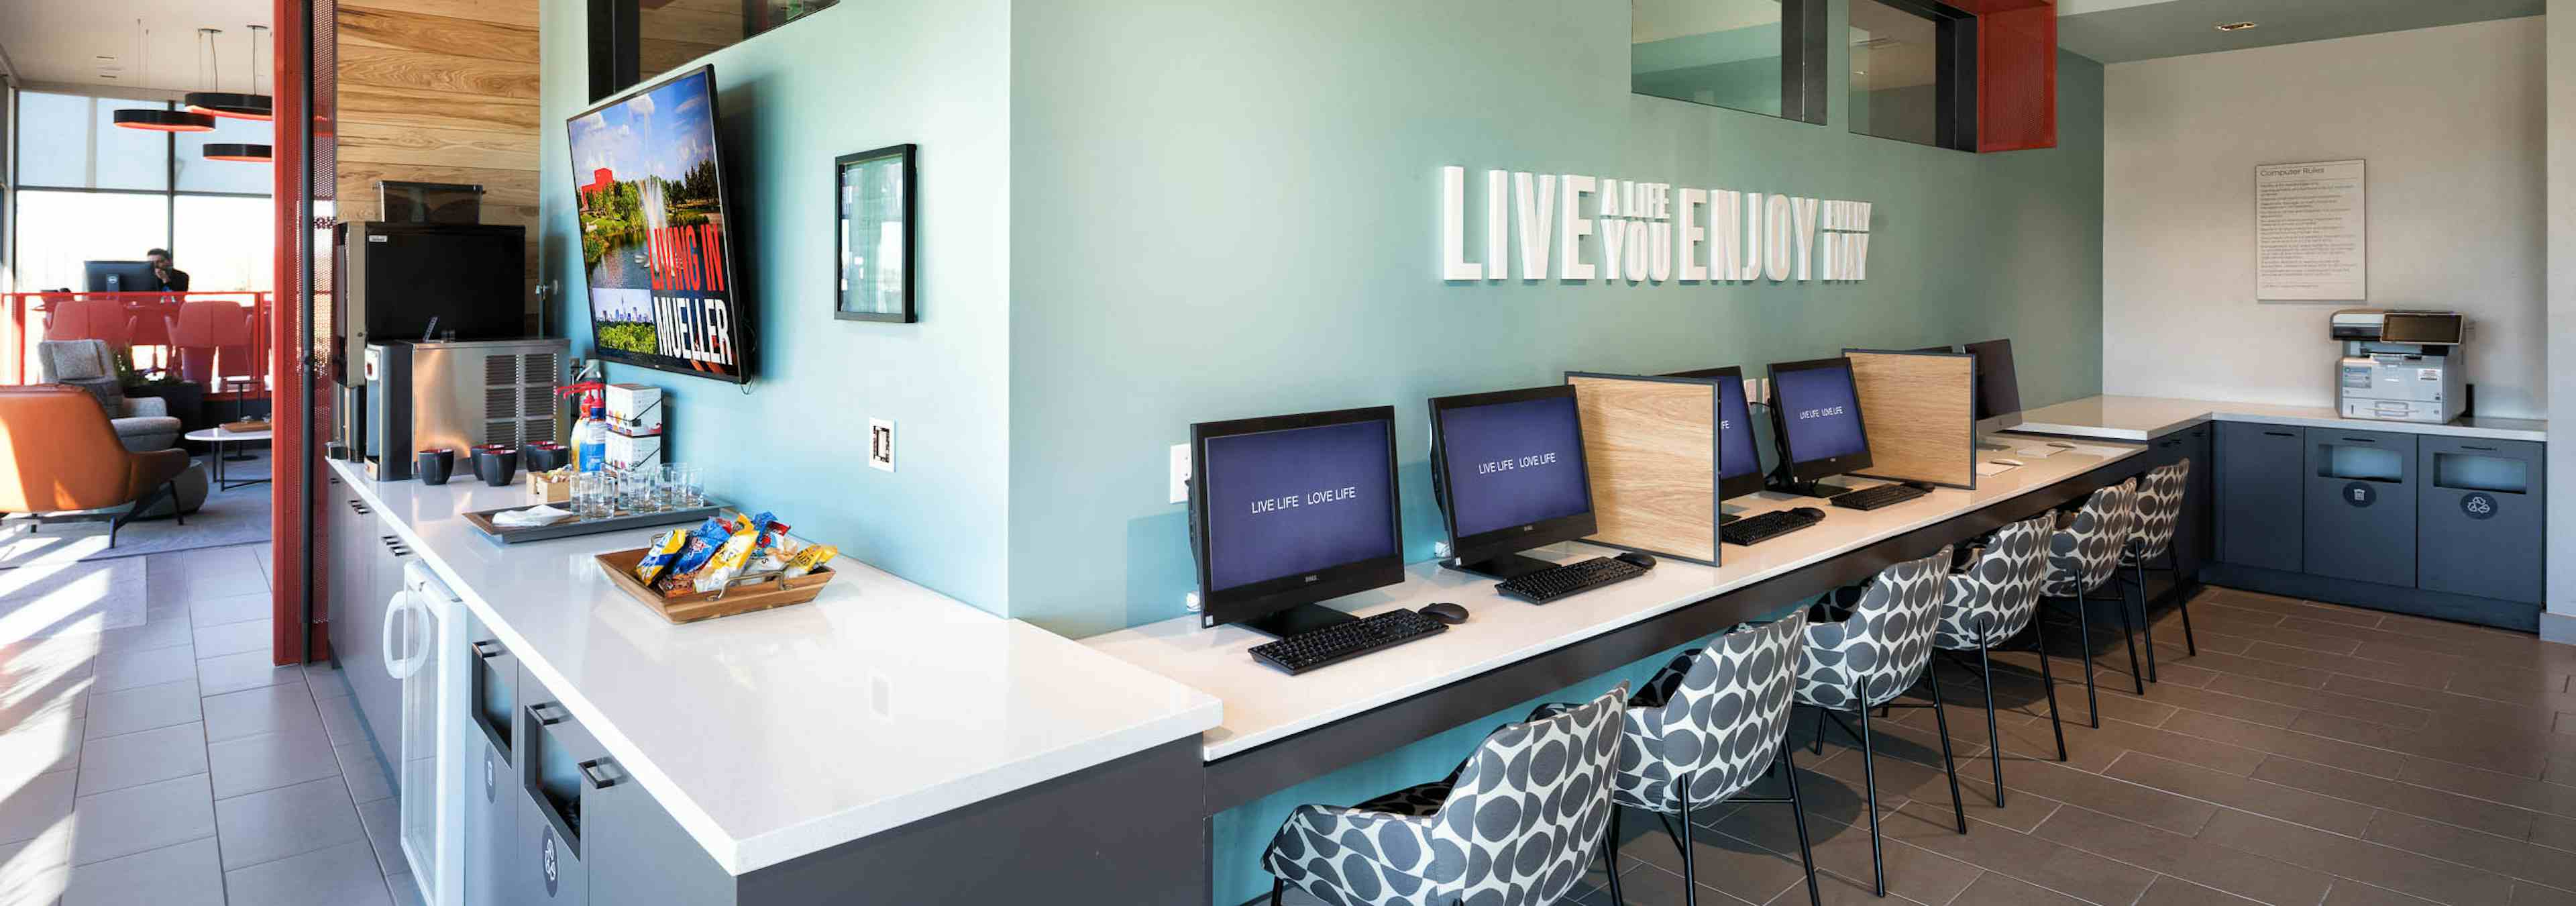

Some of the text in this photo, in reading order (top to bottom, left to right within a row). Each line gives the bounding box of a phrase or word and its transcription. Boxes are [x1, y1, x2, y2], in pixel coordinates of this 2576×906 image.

[1444, 166, 1596, 281] LIVE
[1601, 179, 1670, 219] A LIFE
[646, 223, 724, 291] LIVING IN
[1601, 219, 1671, 281] YOU
[1678, 187, 1819, 281] ENJOY
[1823, 232, 1870, 281] DAY
[653, 296, 733, 365] MUELLER
[1721, 420, 1730, 429] FE
[1479, 452, 1556, 474] LIVE LIFE LOVE LIFE
[1251, 487, 1356, 513] LIVE LIFE LOVE LIFE
